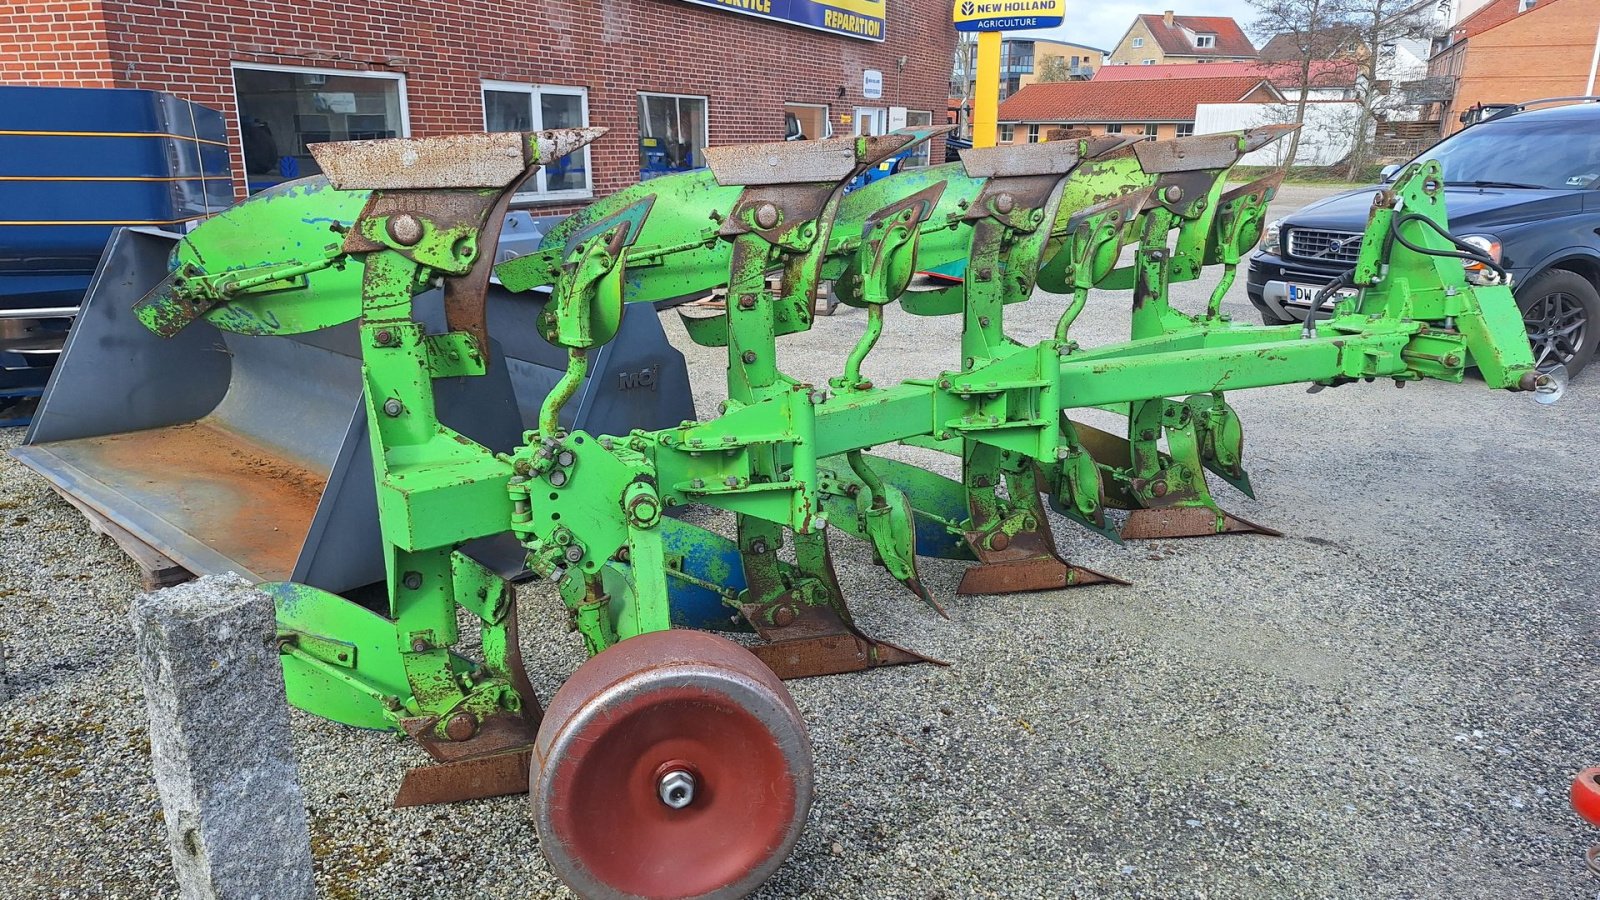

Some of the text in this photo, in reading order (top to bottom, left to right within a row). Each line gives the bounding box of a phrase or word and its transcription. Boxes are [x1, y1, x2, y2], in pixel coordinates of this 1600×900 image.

[977, 0, 1056, 13] NEW HOLLAND
[824, 9, 880, 37] REPARATION
[977, 18, 1037, 28] AGRICULTURE
[1296, 287, 1312, 301] DW
